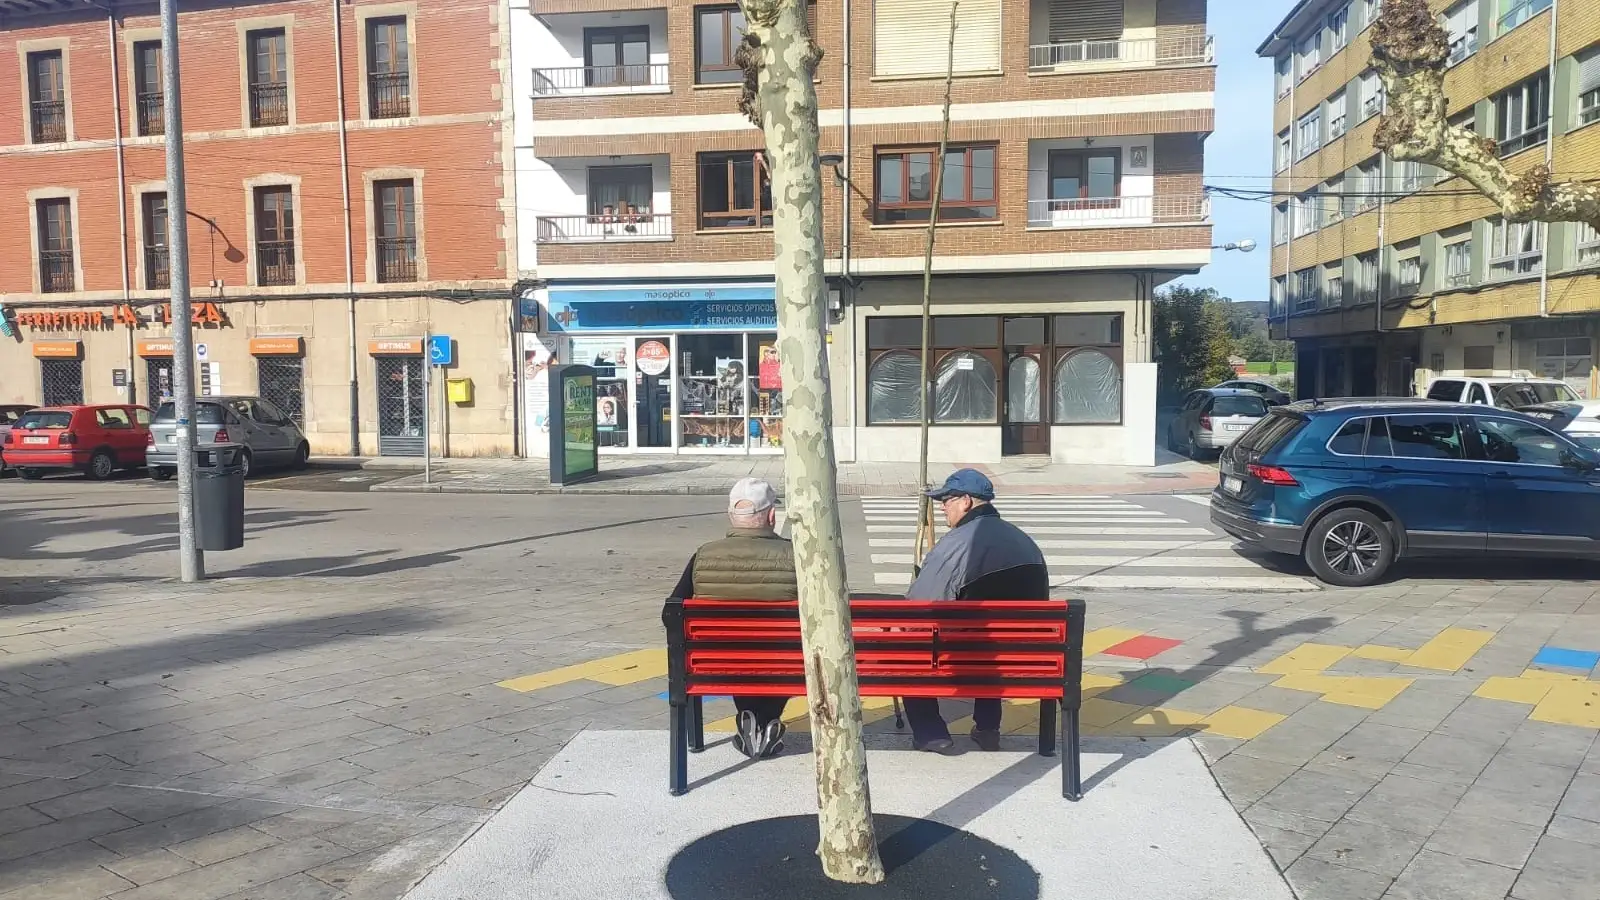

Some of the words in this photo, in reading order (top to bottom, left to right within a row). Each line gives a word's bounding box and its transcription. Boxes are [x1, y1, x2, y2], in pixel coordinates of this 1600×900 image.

[644, 290, 690, 299] masoptico
[113, 304, 137, 323] LA
[151, 302, 222, 322] PLZA
[706, 304, 743, 313] SERVICIOS
[744, 302, 774, 312] ÓPTICOS
[706, 317, 744, 325] SERVICIOS
[746, 316, 777, 325] AUDITIVO
